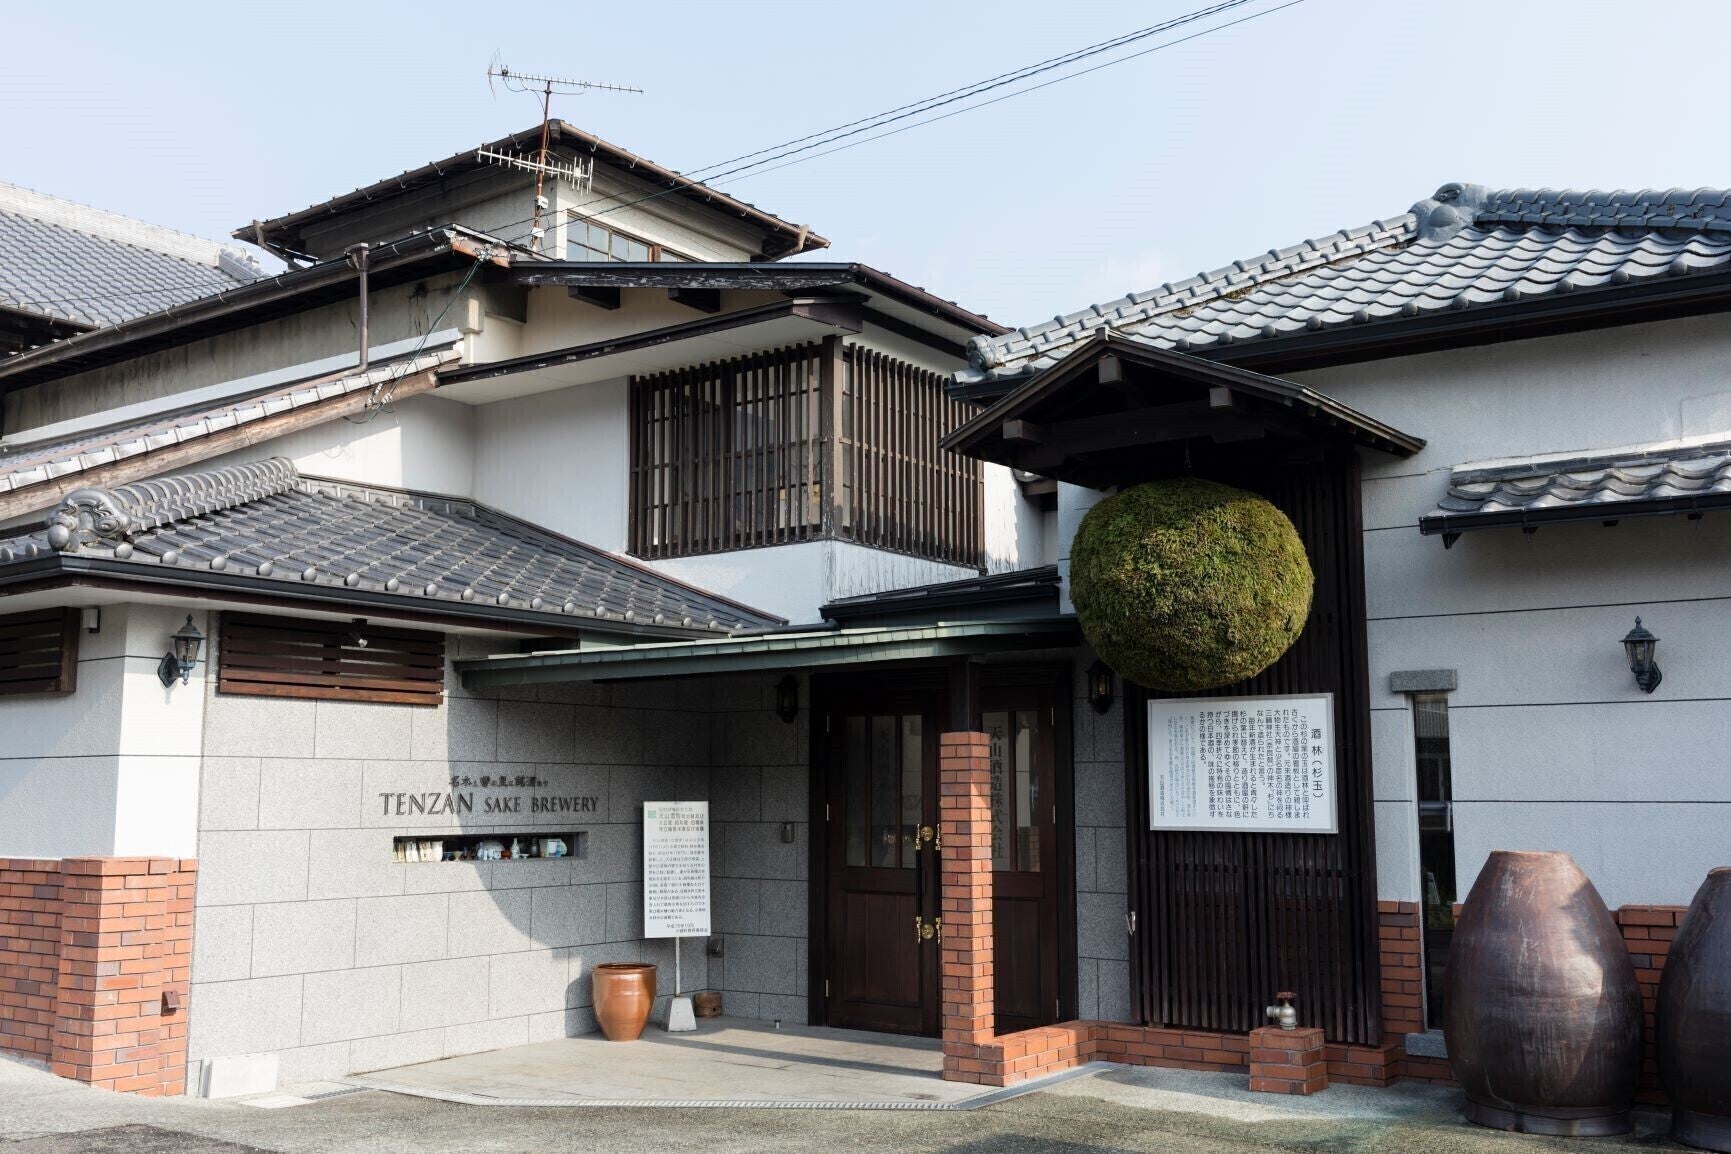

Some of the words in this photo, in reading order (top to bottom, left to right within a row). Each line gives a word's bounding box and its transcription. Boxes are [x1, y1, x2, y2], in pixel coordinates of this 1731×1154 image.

[378, 792, 475, 817] TENZAN
[483, 796, 522, 814] SAKE
[531, 796, 600, 814] BREWERY
